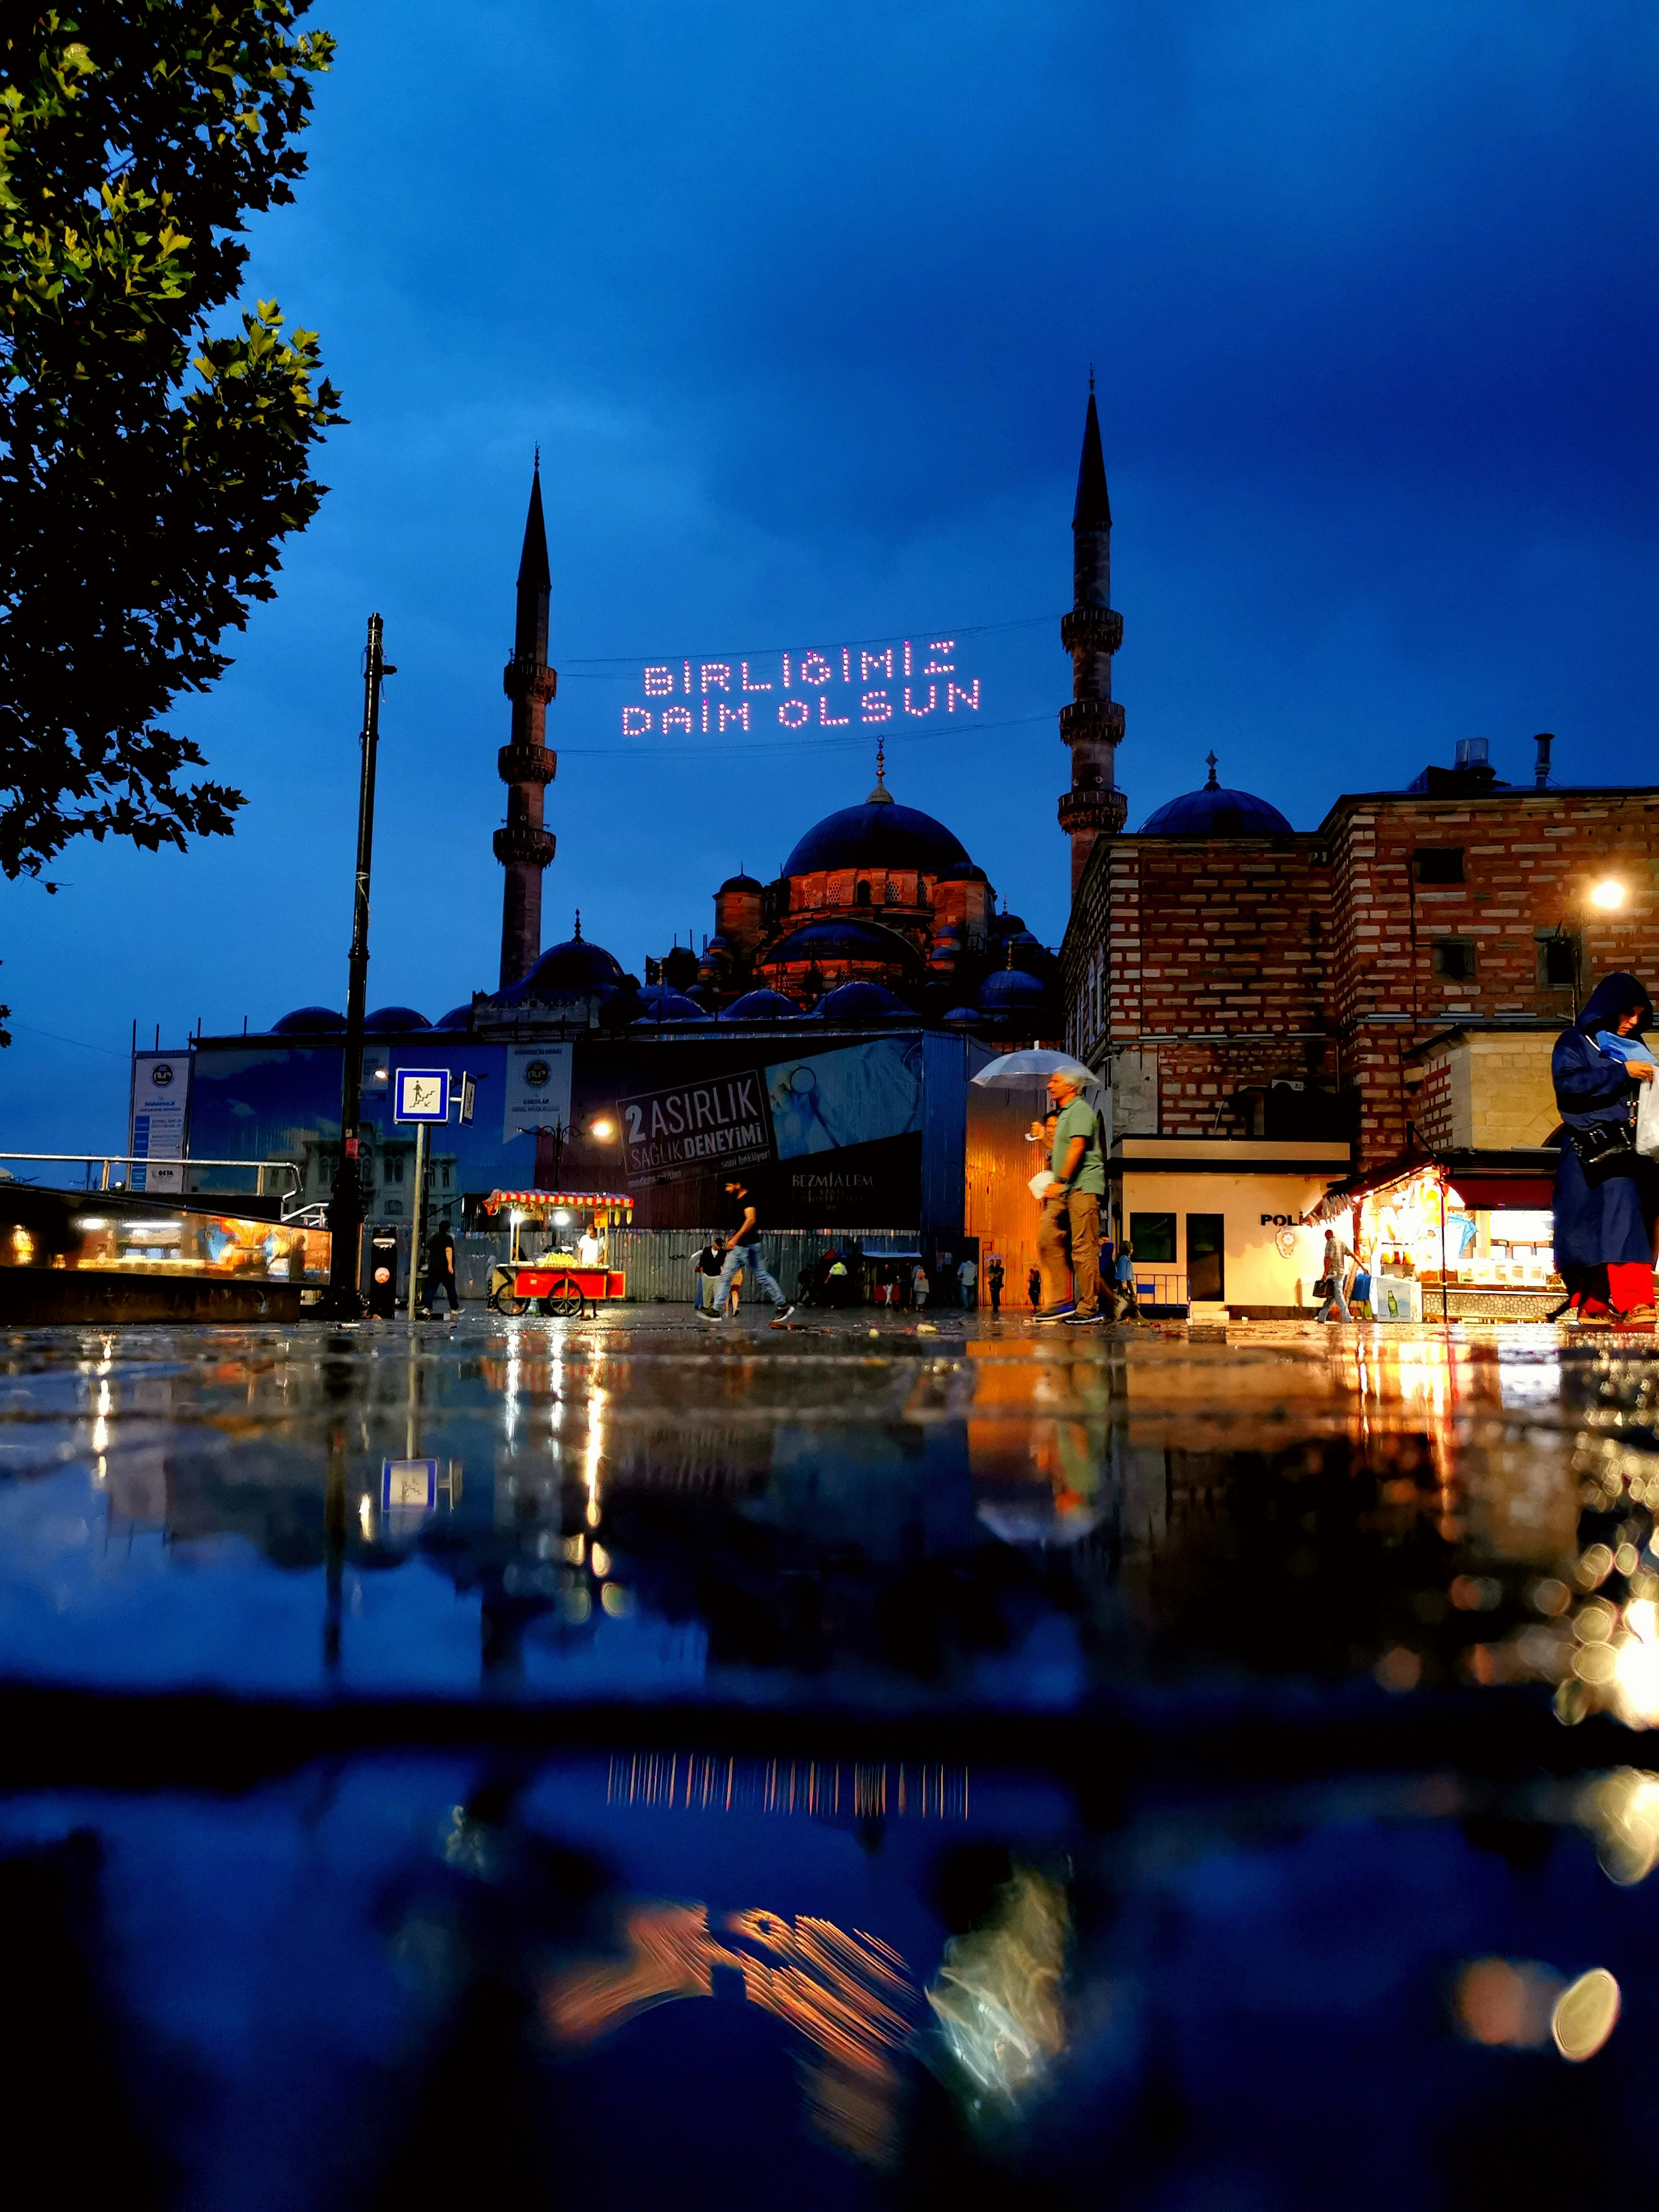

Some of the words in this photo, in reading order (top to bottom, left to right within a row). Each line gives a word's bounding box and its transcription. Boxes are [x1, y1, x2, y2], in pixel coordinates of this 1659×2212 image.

[622, 699, 749, 736] DAİM
[779, 679, 979, 728] OLSUN
[625, 1105, 646, 1144] 2
[651, 1078, 758, 1139] ASIRLIK
[631, 1139, 683, 1170] SAĞLIK
[683, 1122, 763, 1159] DENEYİMİ
